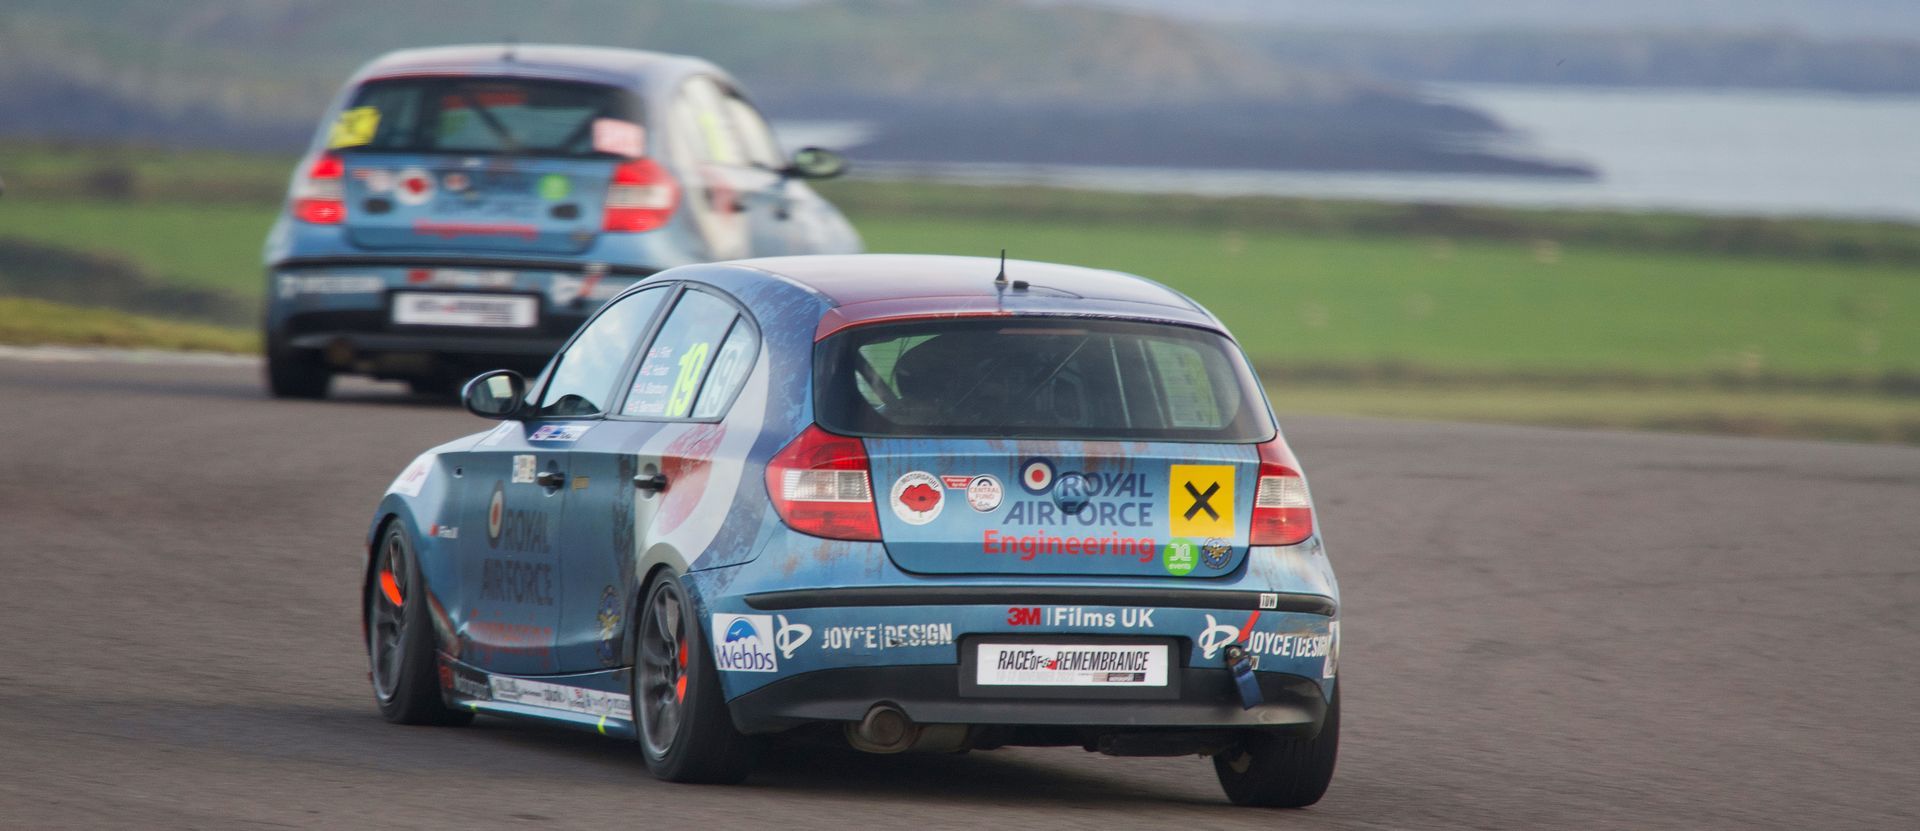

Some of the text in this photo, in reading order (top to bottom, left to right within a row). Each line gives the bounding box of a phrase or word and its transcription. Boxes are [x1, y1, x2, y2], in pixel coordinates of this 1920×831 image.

[665, 342, 709, 417] 19
[970, 486, 1000, 494] CENTRAL
[1061, 472, 1154, 498] ROYAL
[1002, 501, 1154, 527] AIR FORCE
[983, 529, 1156, 563] Engineering
[1007, 607, 1154, 628] 3M Films UK
[715, 644, 774, 670] Webbs
[998, 650, 1031, 670] RACE
[1056, 651, 1150, 671] REMEMBRANCE
